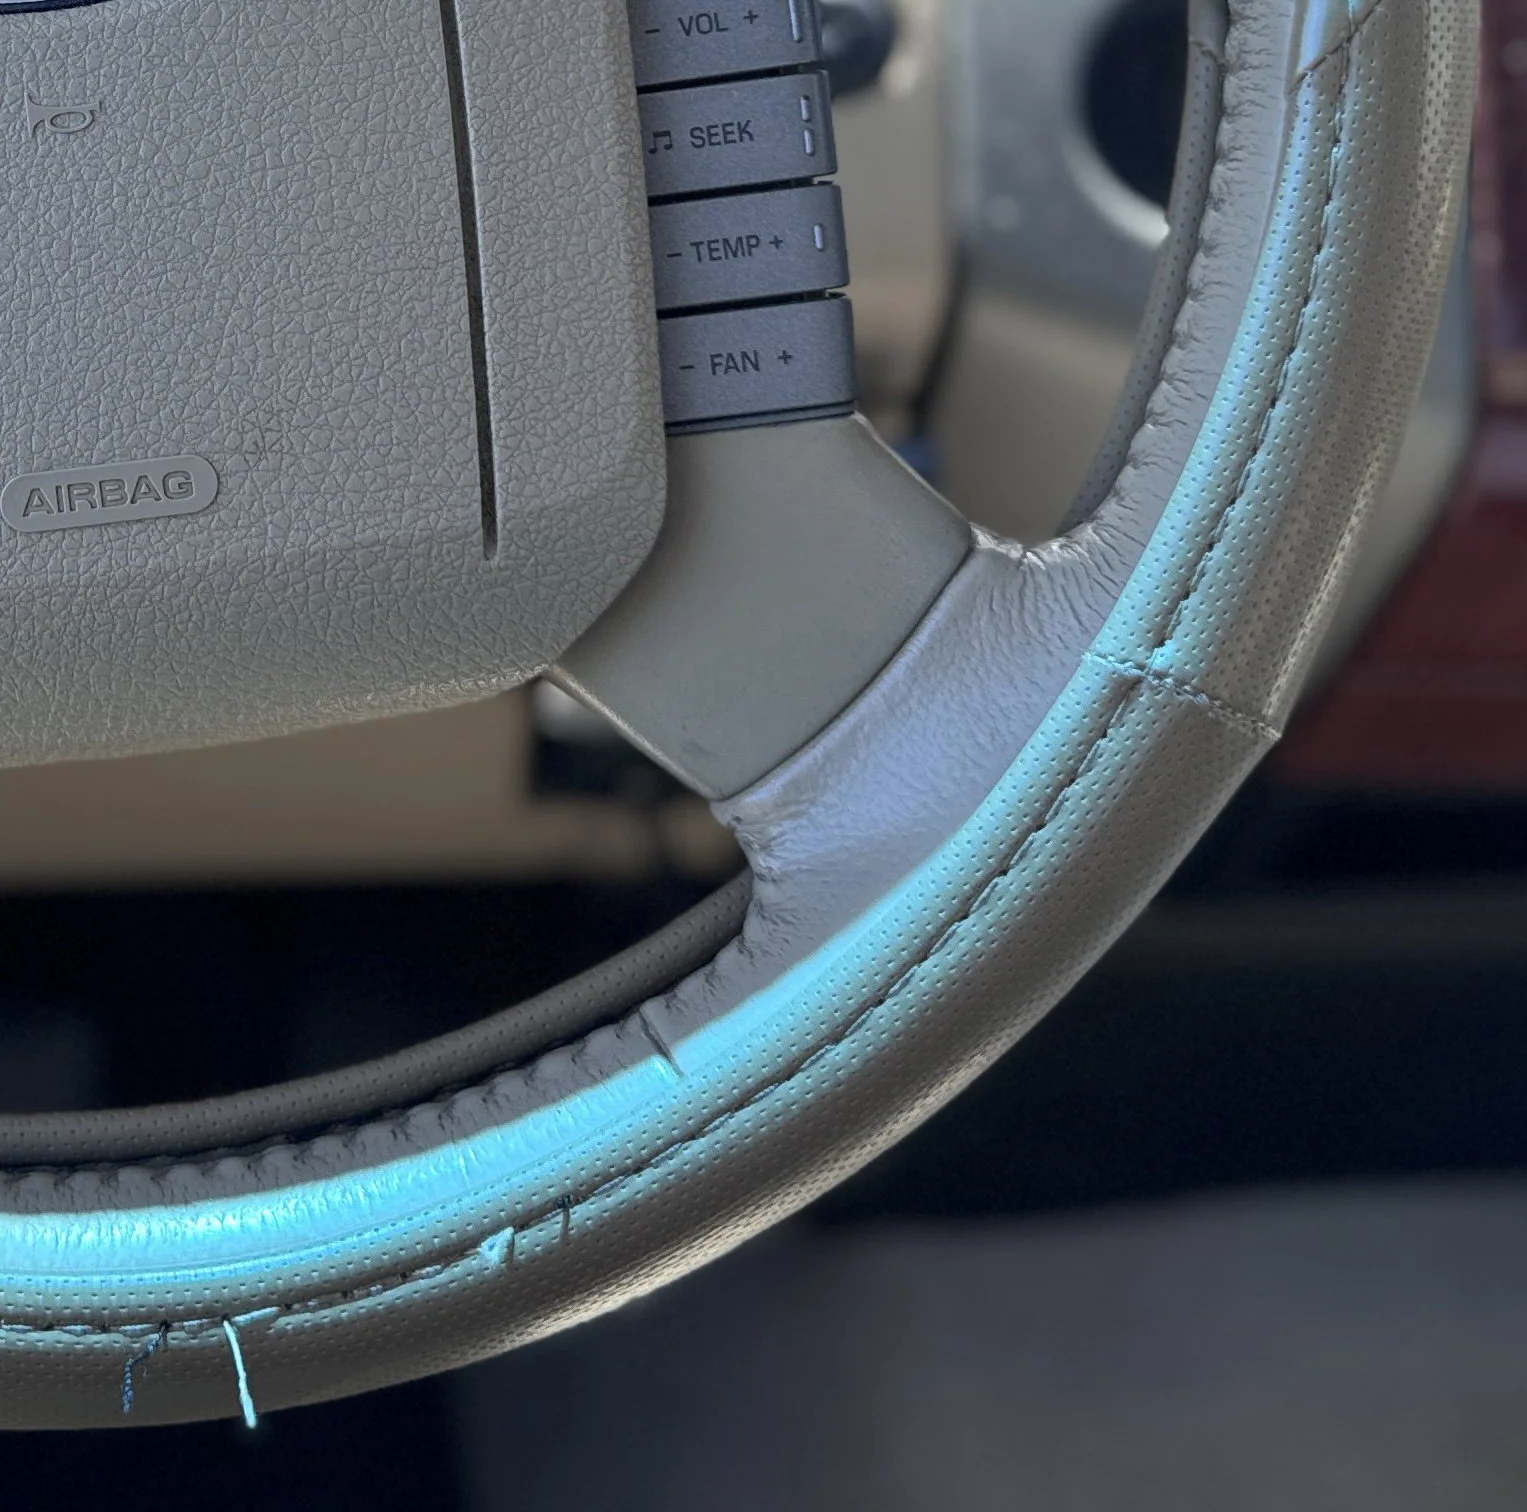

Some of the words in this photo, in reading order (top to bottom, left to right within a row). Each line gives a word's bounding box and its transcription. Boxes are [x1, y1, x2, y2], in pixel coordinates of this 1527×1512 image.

[678, 12, 728, 37] VOL
[689, 119, 754, 149] SEEK
[690, 234, 762, 263] TEMP
[710, 349, 760, 376] FAN
[22, 469, 196, 518] AIRBAG
